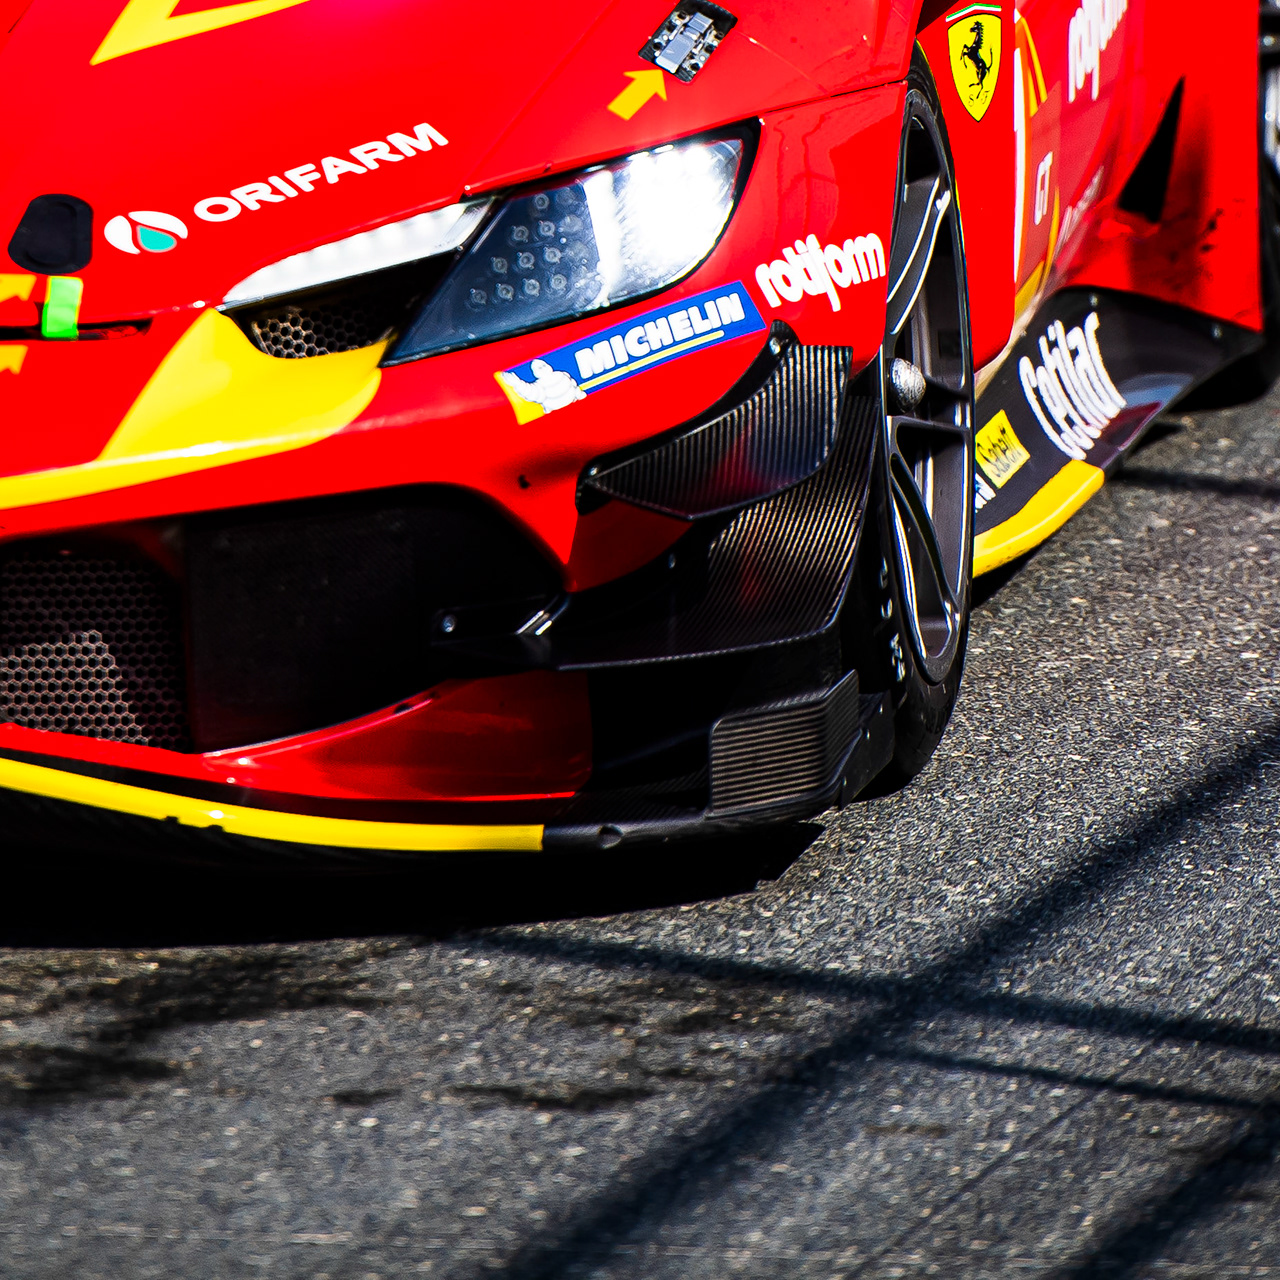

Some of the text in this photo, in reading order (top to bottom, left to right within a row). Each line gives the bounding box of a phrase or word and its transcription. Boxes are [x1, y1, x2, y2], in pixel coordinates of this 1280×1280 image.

[193, 122, 450, 223] ORIFARM
[755, 232, 887, 312] rotiform
[573, 292, 746, 380] MICHELIN
[1018, 310, 1128, 461] Cetilar
